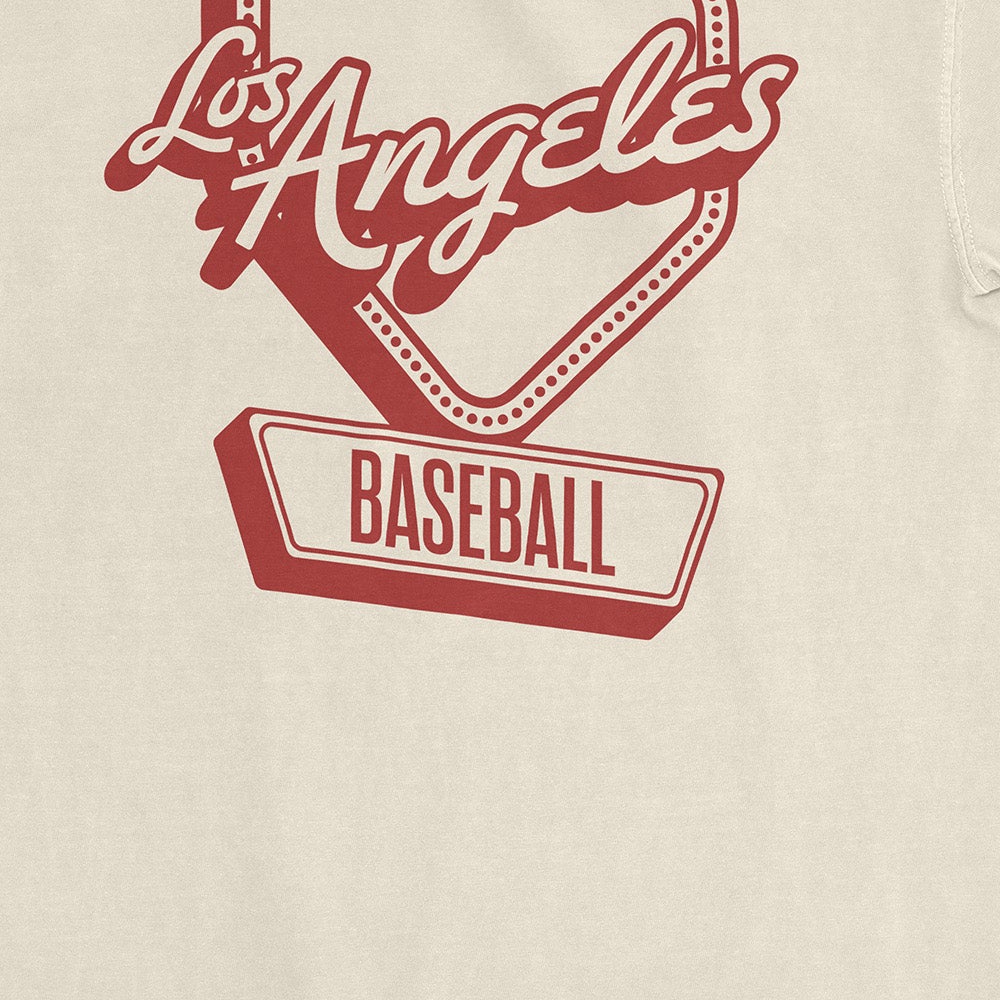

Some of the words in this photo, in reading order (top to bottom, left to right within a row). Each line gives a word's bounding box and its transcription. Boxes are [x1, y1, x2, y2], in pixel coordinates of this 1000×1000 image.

[128, 25, 298, 166] Los
[230, 25, 792, 276] Angeles
[350, 448, 616, 577] BASEBALL
